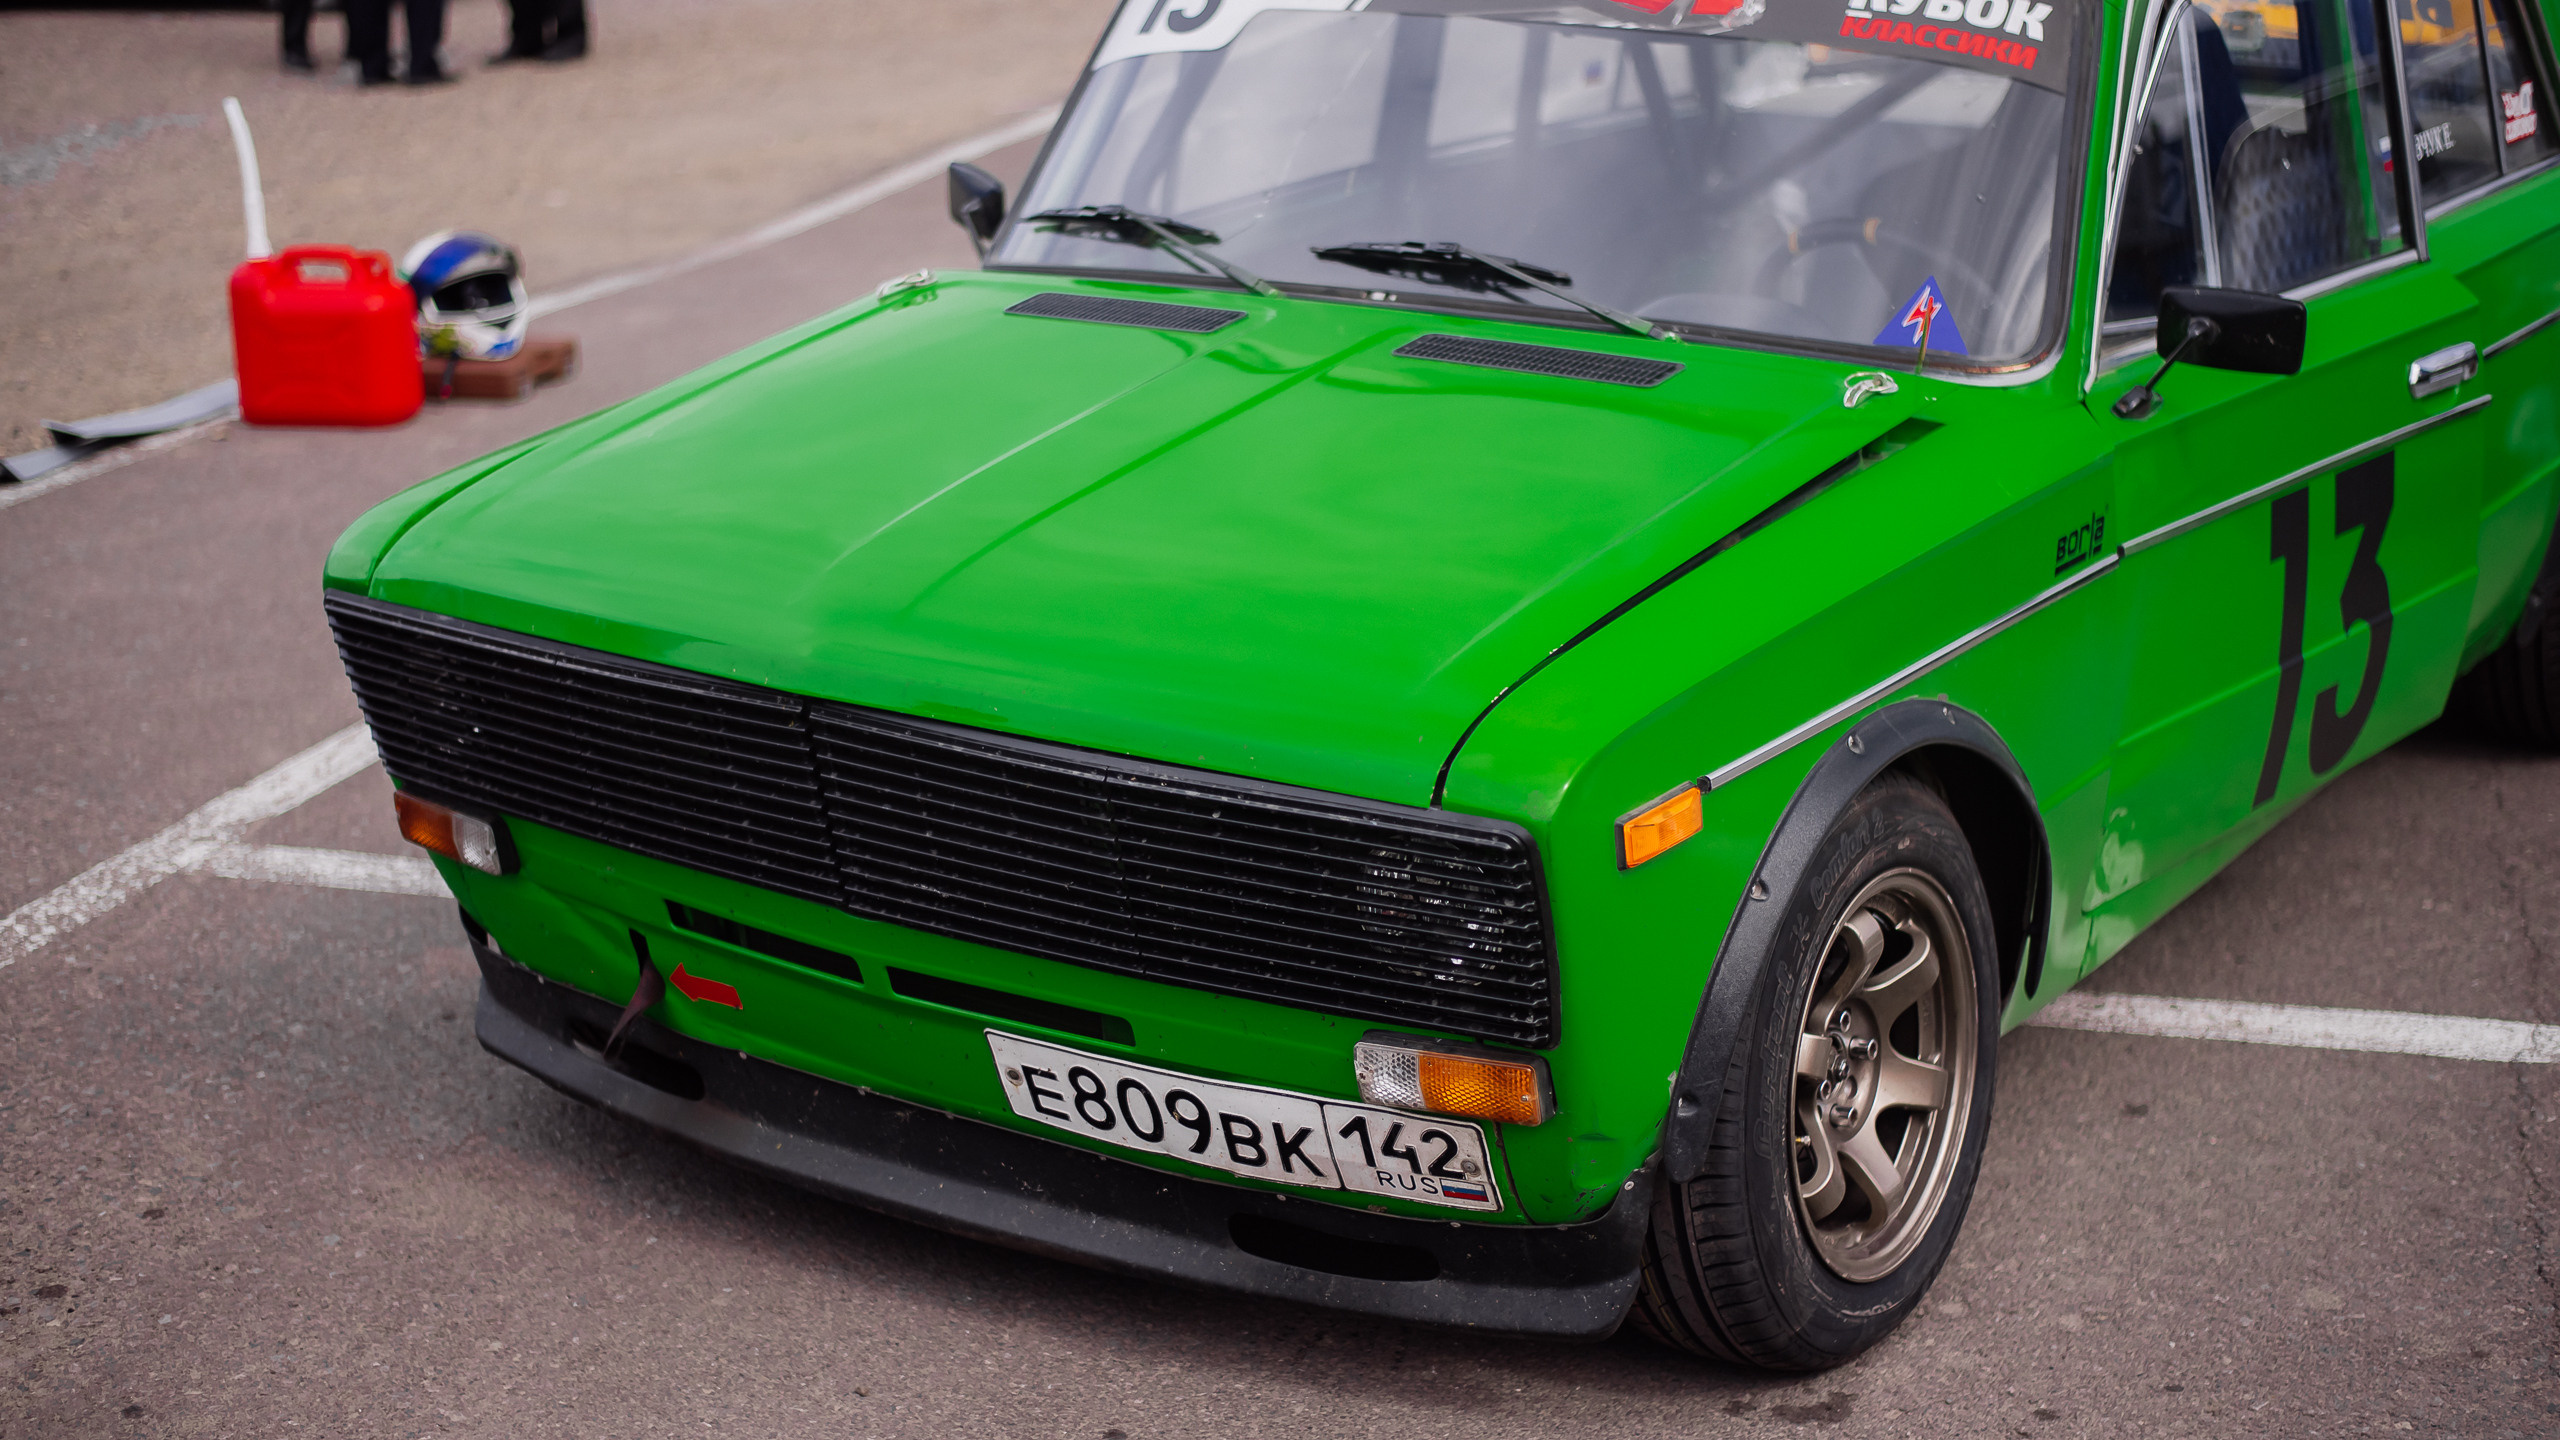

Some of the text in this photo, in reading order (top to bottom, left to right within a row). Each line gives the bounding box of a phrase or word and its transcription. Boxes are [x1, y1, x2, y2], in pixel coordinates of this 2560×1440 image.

[1840, 16, 2039, 70] КЛАССИКИ
[2252, 450, 2395, 811] 13
[1339, 1115, 1466, 1179] 142
[1376, 1170, 1439, 1195] RUS
